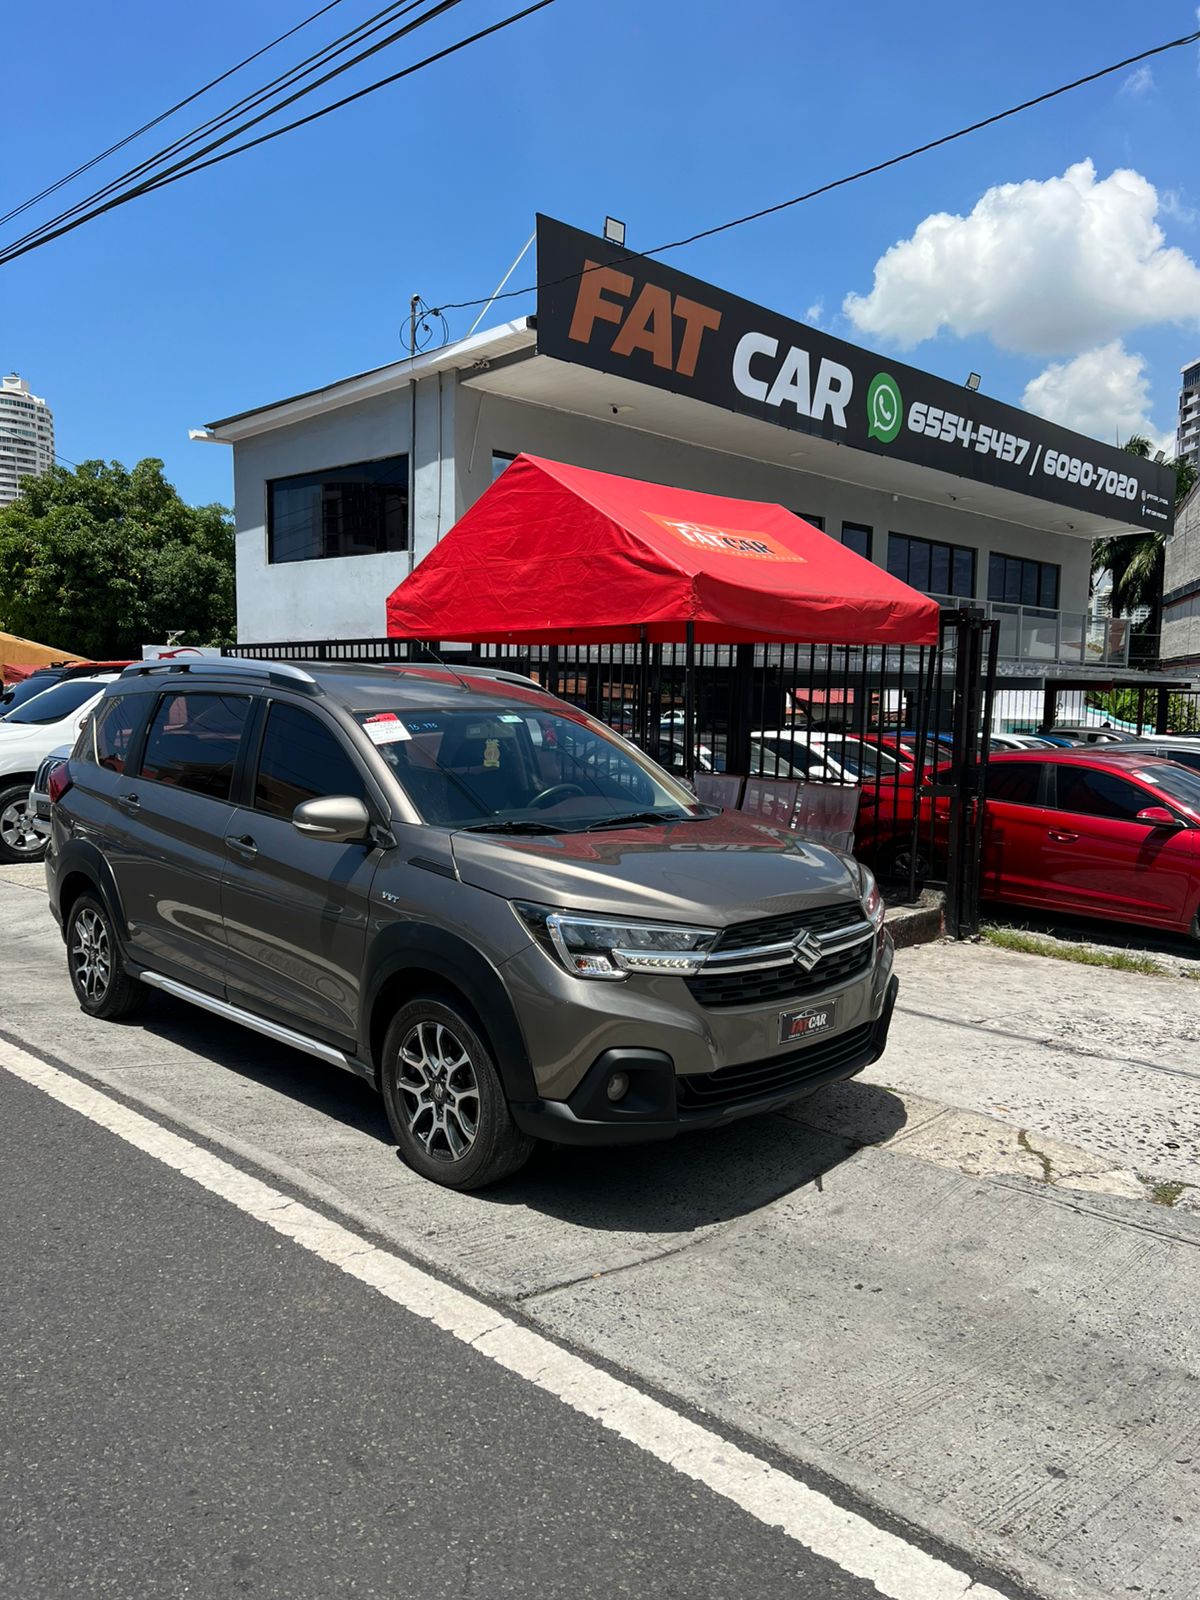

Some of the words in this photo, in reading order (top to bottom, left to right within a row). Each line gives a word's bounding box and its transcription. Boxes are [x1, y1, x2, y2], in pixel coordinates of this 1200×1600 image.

[568, 259, 722, 377] FAT
[732, 332, 854, 428] CAR
[907, 401, 1031, 465] 6554-5437
[1043, 449, 1138, 500] 6090-7020
